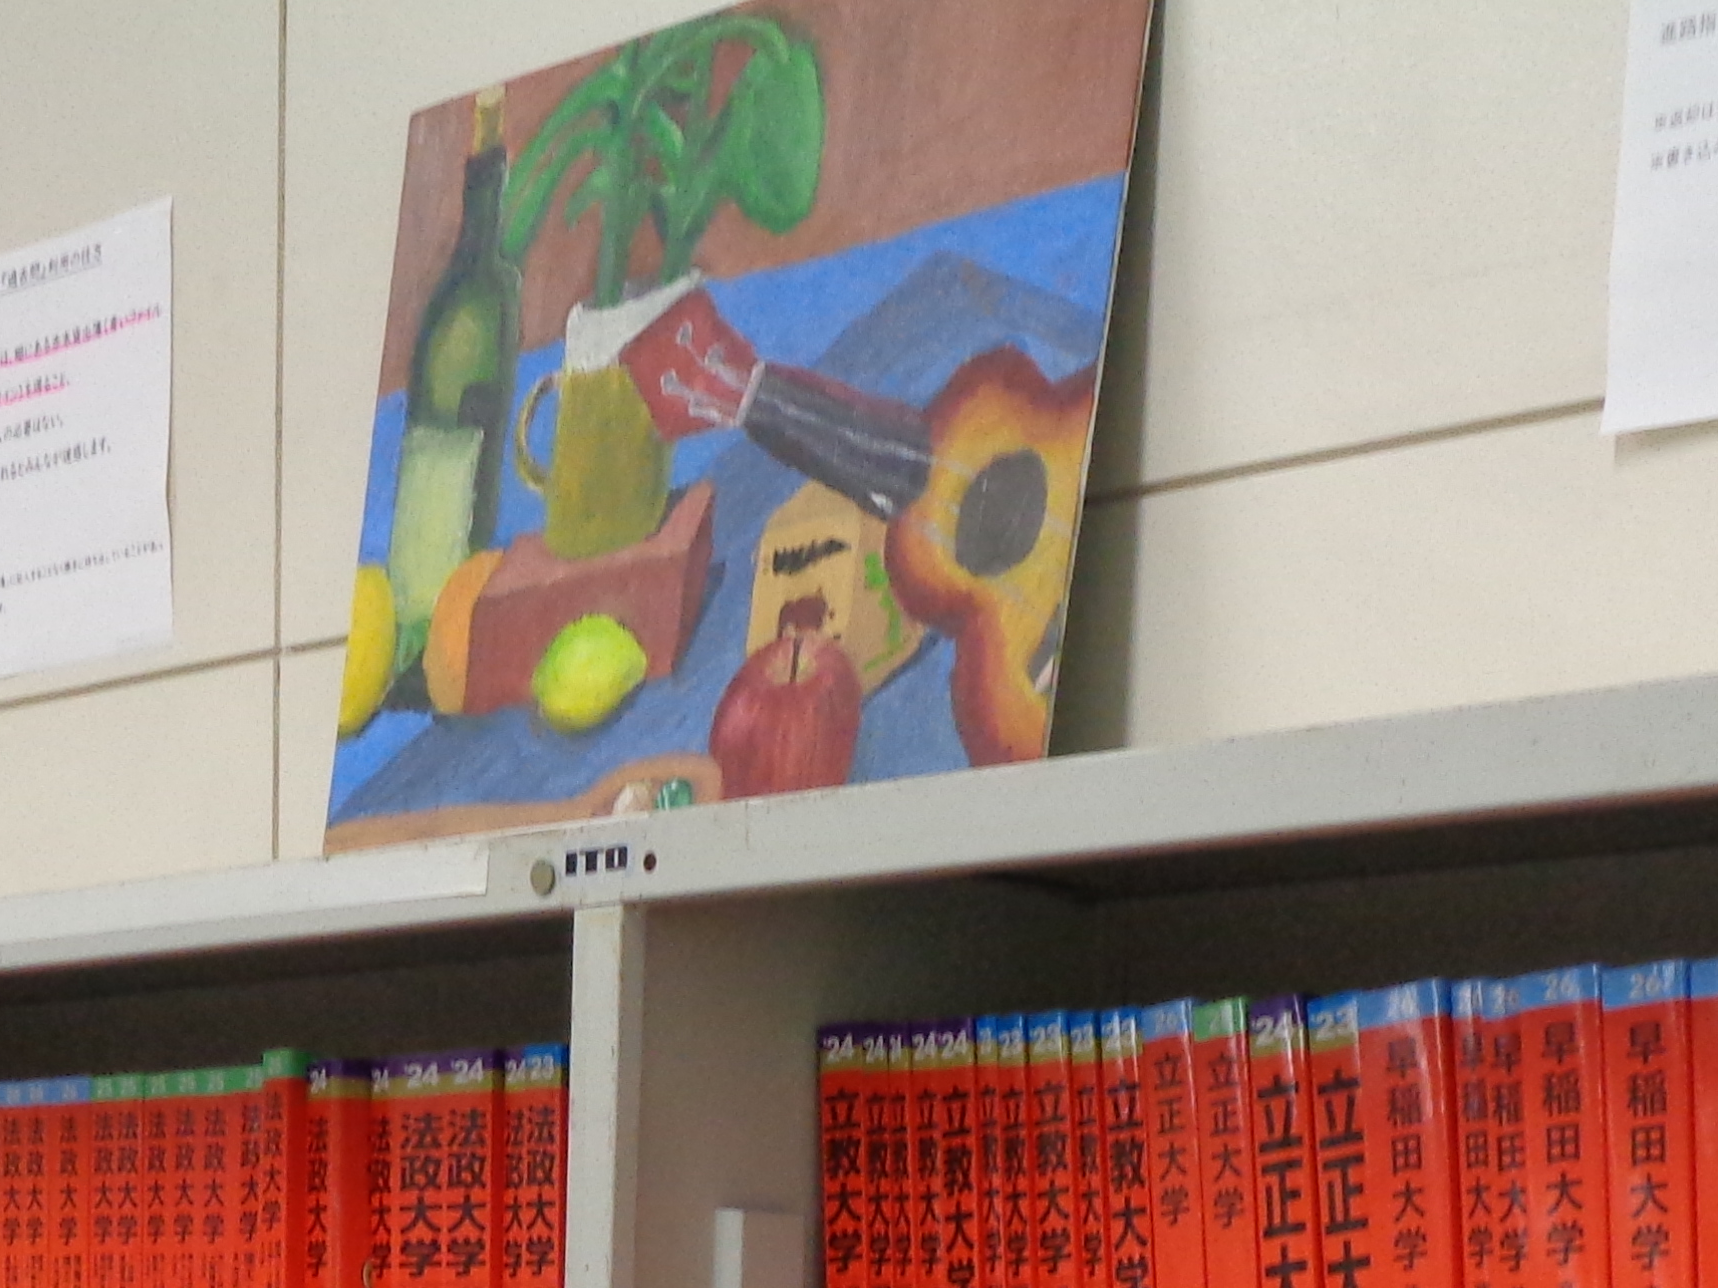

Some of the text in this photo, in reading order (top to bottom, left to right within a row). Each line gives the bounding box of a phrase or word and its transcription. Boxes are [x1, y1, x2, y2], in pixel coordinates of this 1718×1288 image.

[399, 1109, 442, 1278] 法政大学
[447, 1108, 486, 1278] 法政大学
[526, 1105, 554, 1277] 法政大学
[824, 1085, 864, 1273] 立教大学
[1032, 1081, 1072, 1273] 立教大学
[1154, 1051, 1191, 1228] 立正大学
